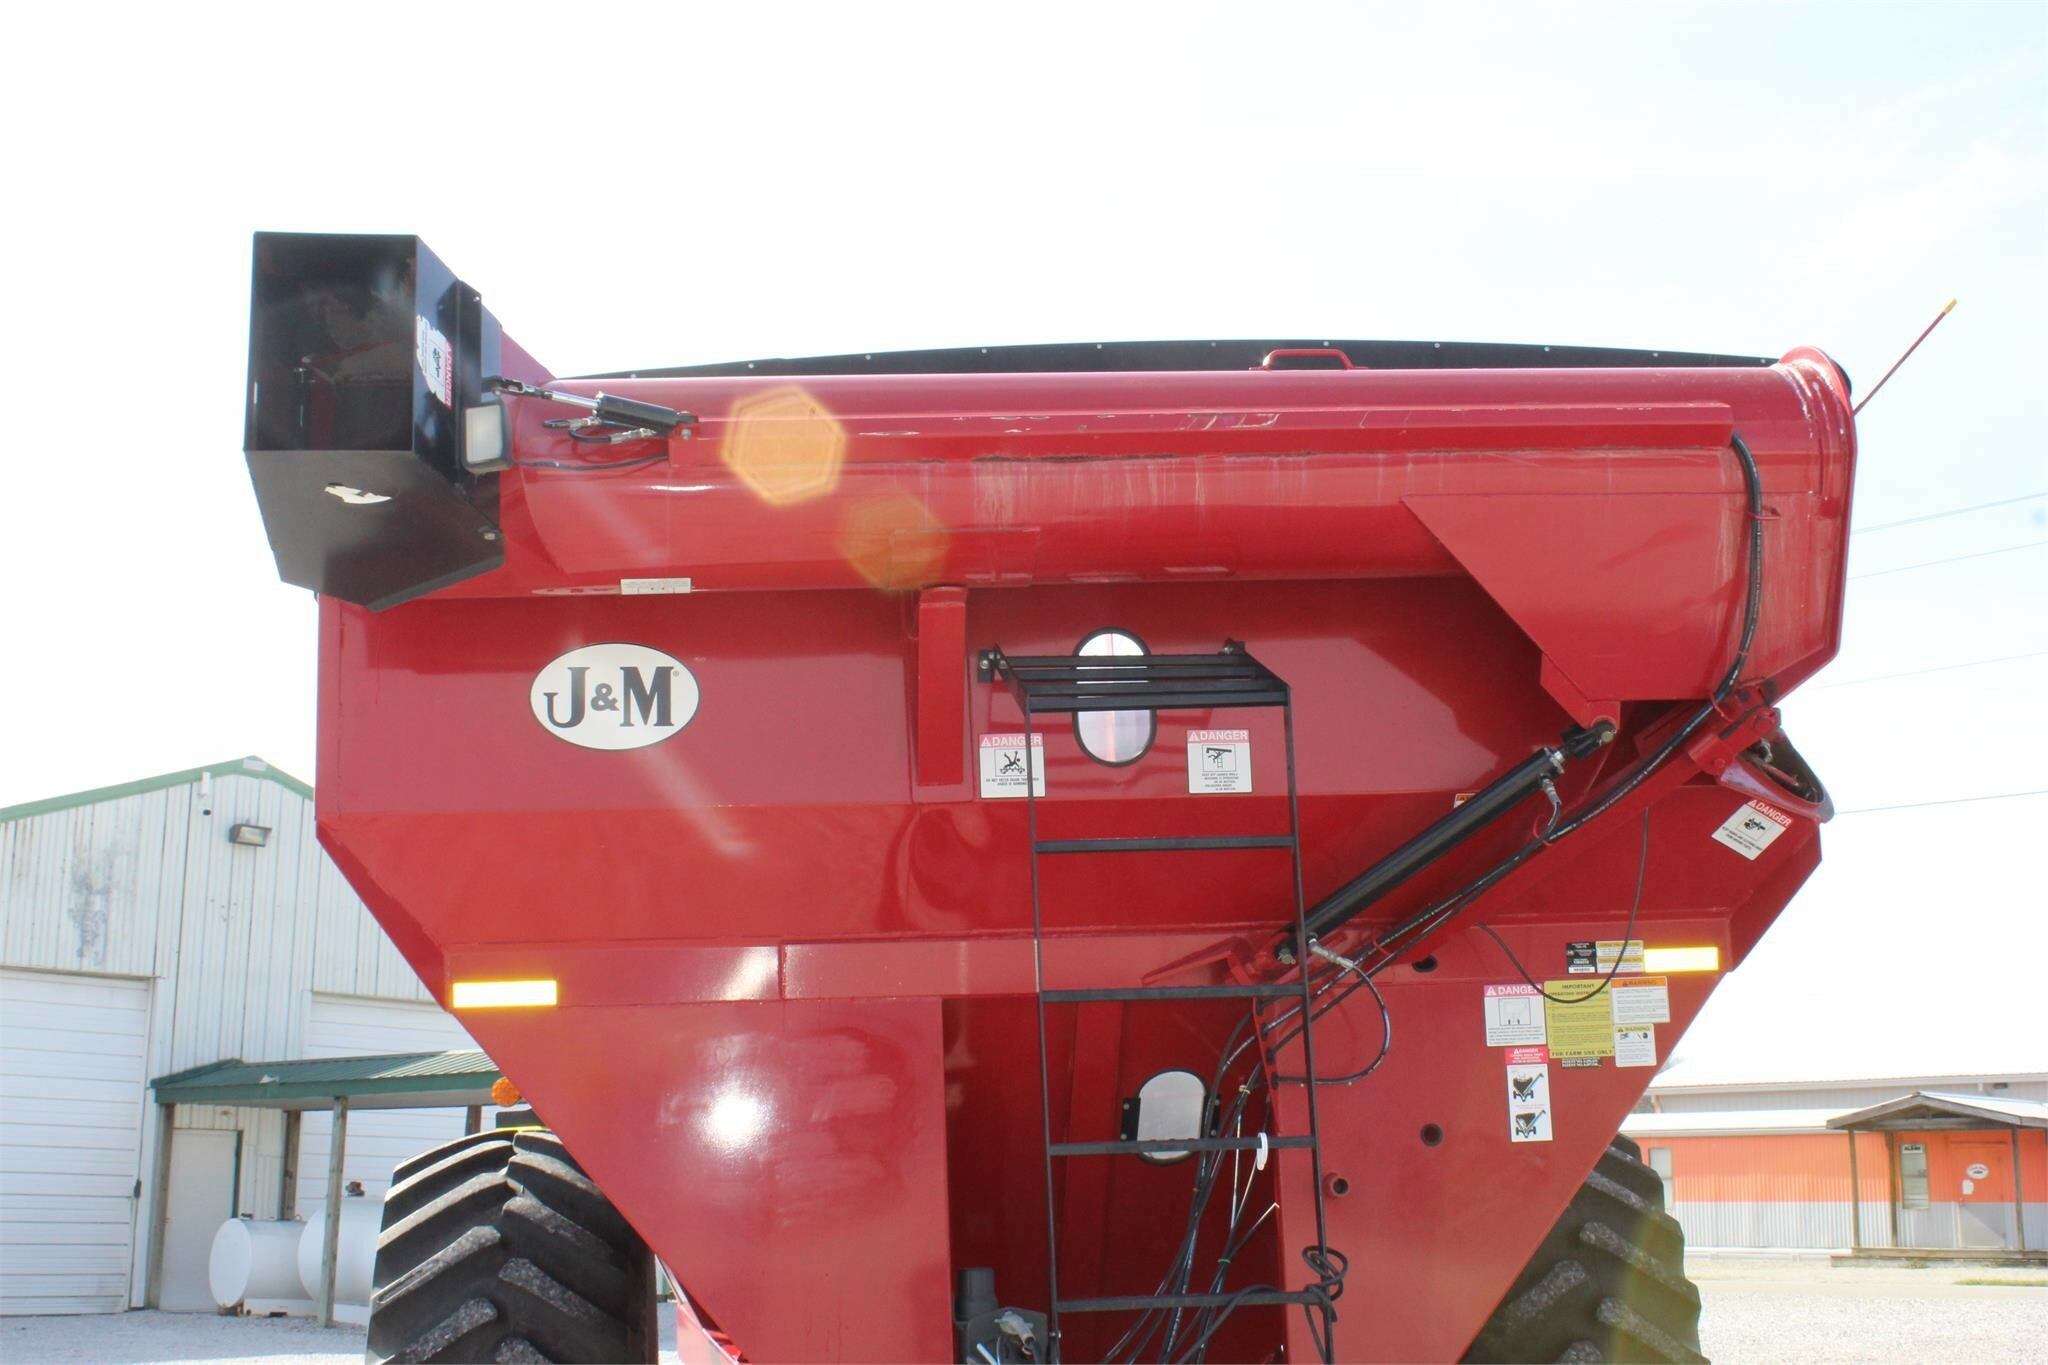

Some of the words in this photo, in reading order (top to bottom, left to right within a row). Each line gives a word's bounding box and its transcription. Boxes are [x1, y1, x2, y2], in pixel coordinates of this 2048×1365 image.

[543, 666, 675, 729] J&M
[1200, 731, 1248, 741] DANGER
[1756, 802, 1792, 827] DANGER
